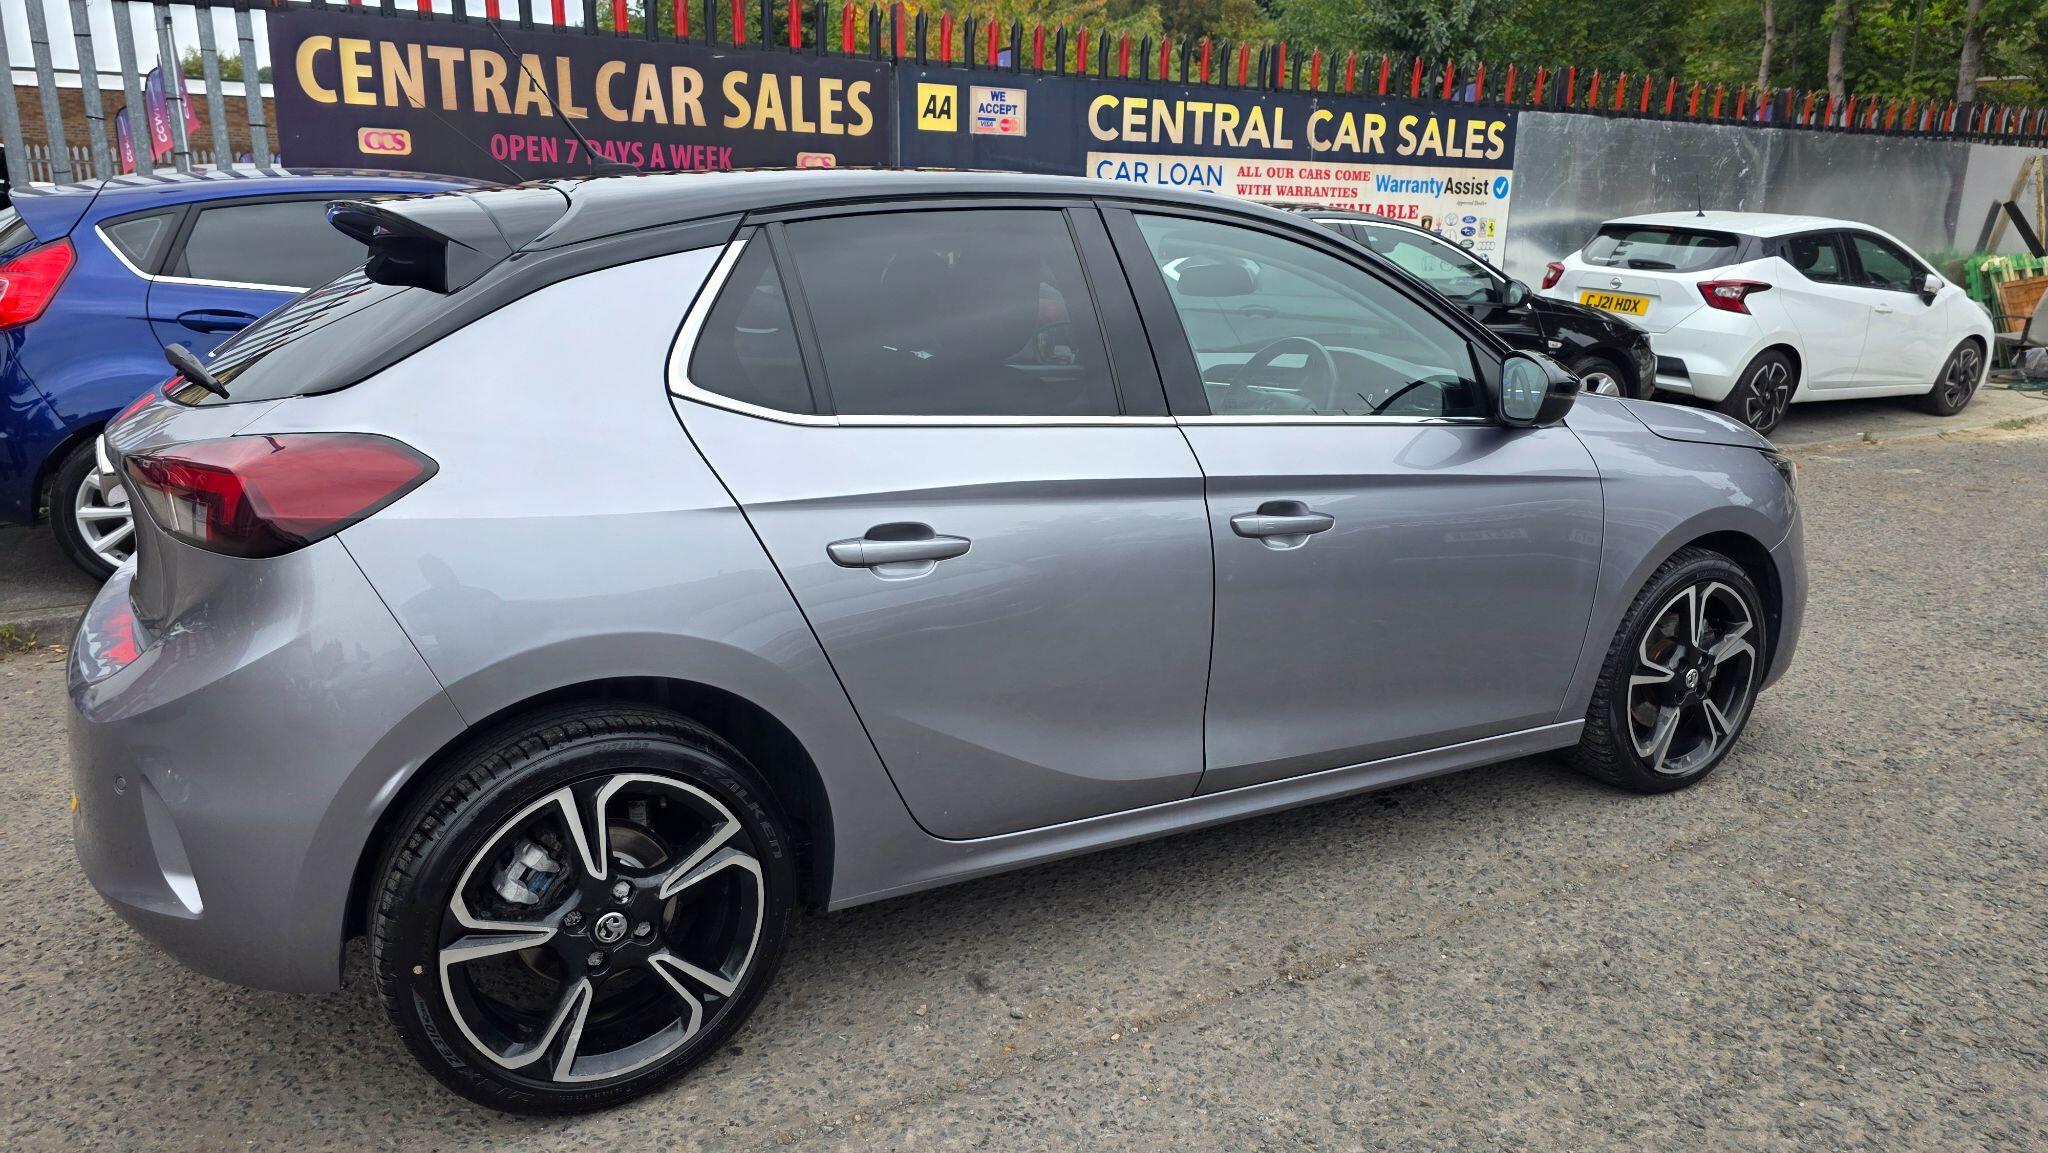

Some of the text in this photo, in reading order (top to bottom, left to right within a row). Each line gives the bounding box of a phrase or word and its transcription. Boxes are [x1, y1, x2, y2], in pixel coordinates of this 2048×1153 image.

[295, 35, 874, 137] CENTRAL CAR SALES
[990, 90, 1006, 102] WE
[922, 94, 952, 120] AA
[978, 102, 1018, 116] ACCEPT
[1087, 94, 1507, 160] CENTRAL CAR SALES
[490, 133, 558, 164] OPEN
[564, 138, 579, 164] 7
[650, 142, 666, 168] A
[669, 143, 733, 170] WEEK
[1096, 160, 1223, 187] CAR LOAN
[1236, 166, 1371, 182] ALL OUR CARS COME
[1236, 184, 1359, 198] WITH WARRANTIES
[1586, 294, 1641, 312] CJ21 HDX
